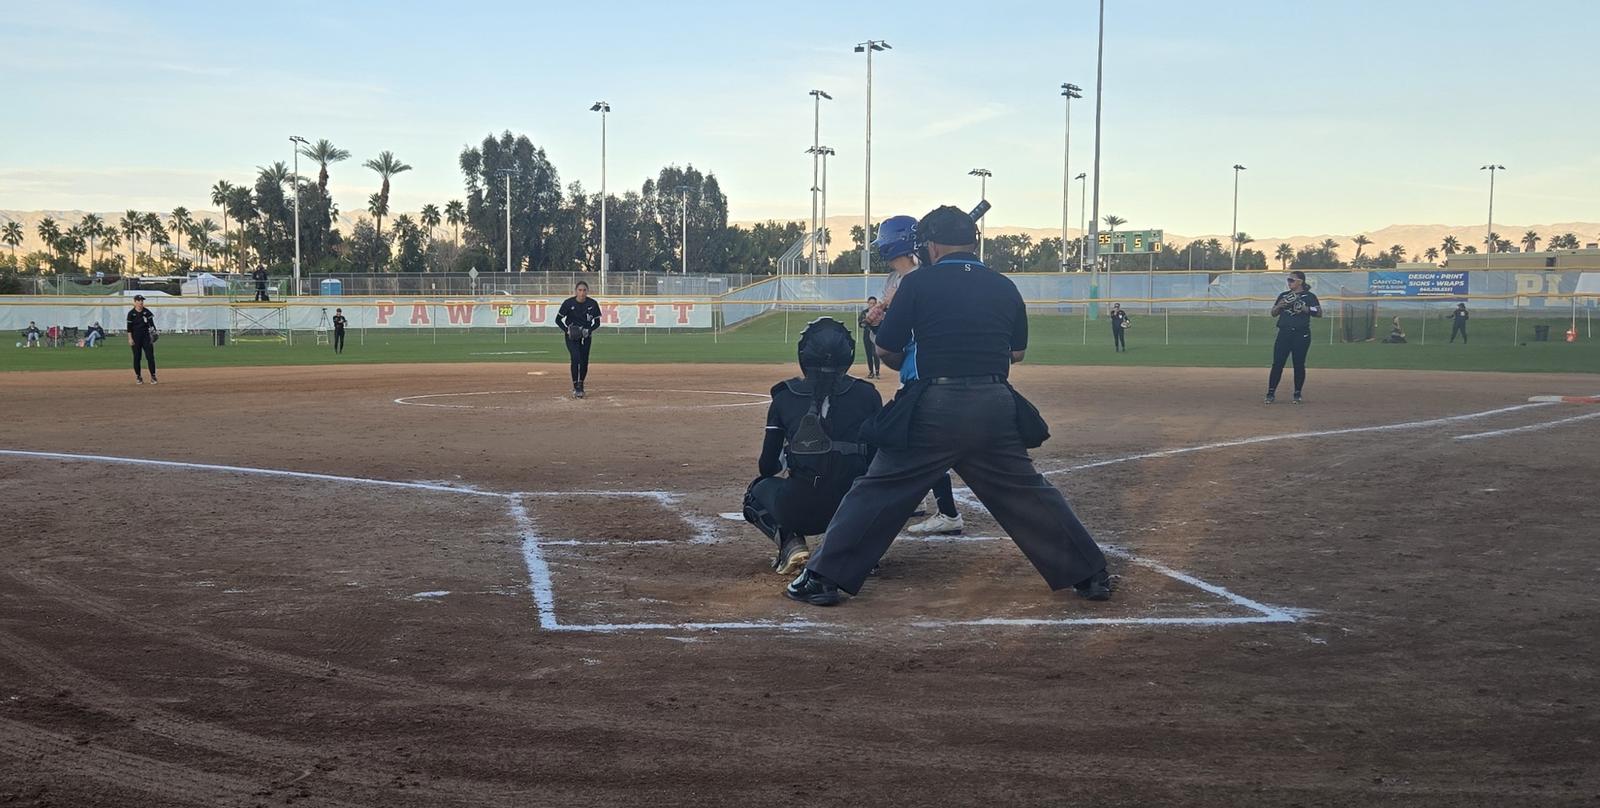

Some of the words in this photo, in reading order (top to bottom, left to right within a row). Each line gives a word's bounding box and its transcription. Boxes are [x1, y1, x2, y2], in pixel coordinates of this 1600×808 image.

[964, 264, 971, 272] S
[375, 300, 695, 326] PAWTUKET
[499, 307, 512, 316] 220
